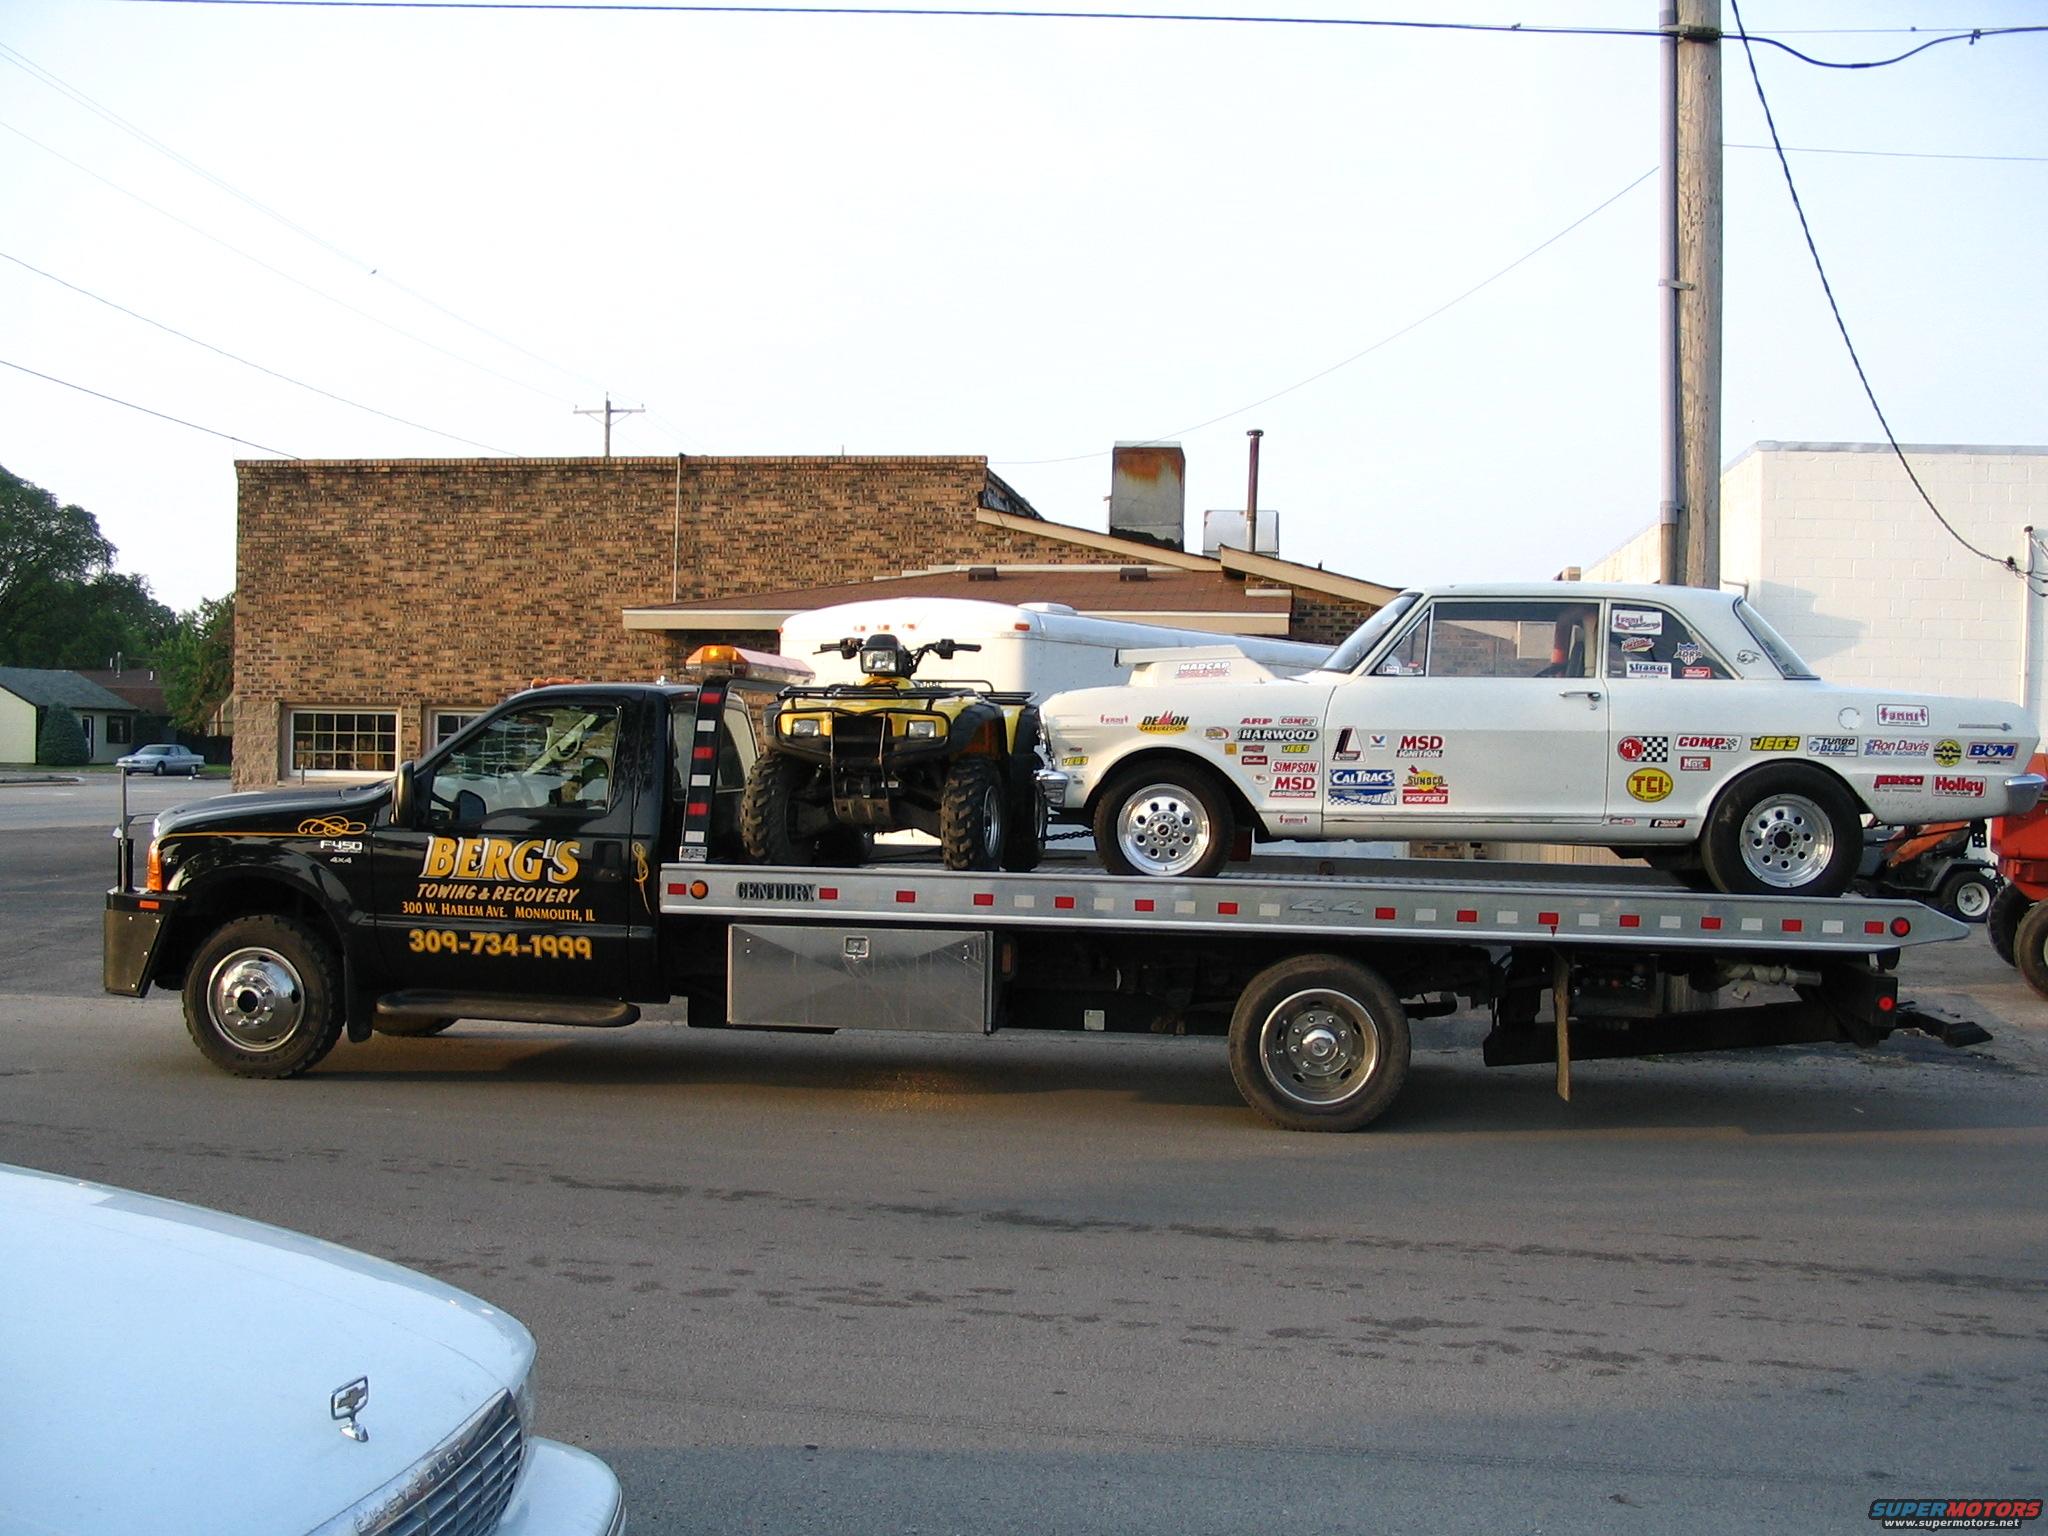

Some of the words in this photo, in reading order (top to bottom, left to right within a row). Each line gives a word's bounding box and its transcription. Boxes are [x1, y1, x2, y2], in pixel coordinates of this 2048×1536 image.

[1241, 729, 1318, 740] HARWOOD
[1400, 736, 1443, 750] MSD
[1678, 736, 1726, 748] COMP
[1872, 739, 1896, 751] Ron
[1897, 740, 1930, 751] Davis
[1969, 743, 2014, 757] B&M
[1273, 761, 1317, 773] SIMPSON
[1274, 776, 1316, 790] MSD
[1407, 775, 1444, 786] SUNOCO
[1632, 775, 1664, 793] TCI
[1934, 775, 1984, 798] Holley
[417, 834, 582, 885] BERG'S
[416, 883, 477, 900] TOWING
[478, 887, 490, 901] &
[492, 886, 580, 905] RECOVERY
[736, 881, 817, 902] CENTURY
[402, 901, 423, 915] 300
[425, 902, 439, 915] W.
[441, 903, 484, 918] HARLEM
[408, 927, 594, 961] 309-734-1999
